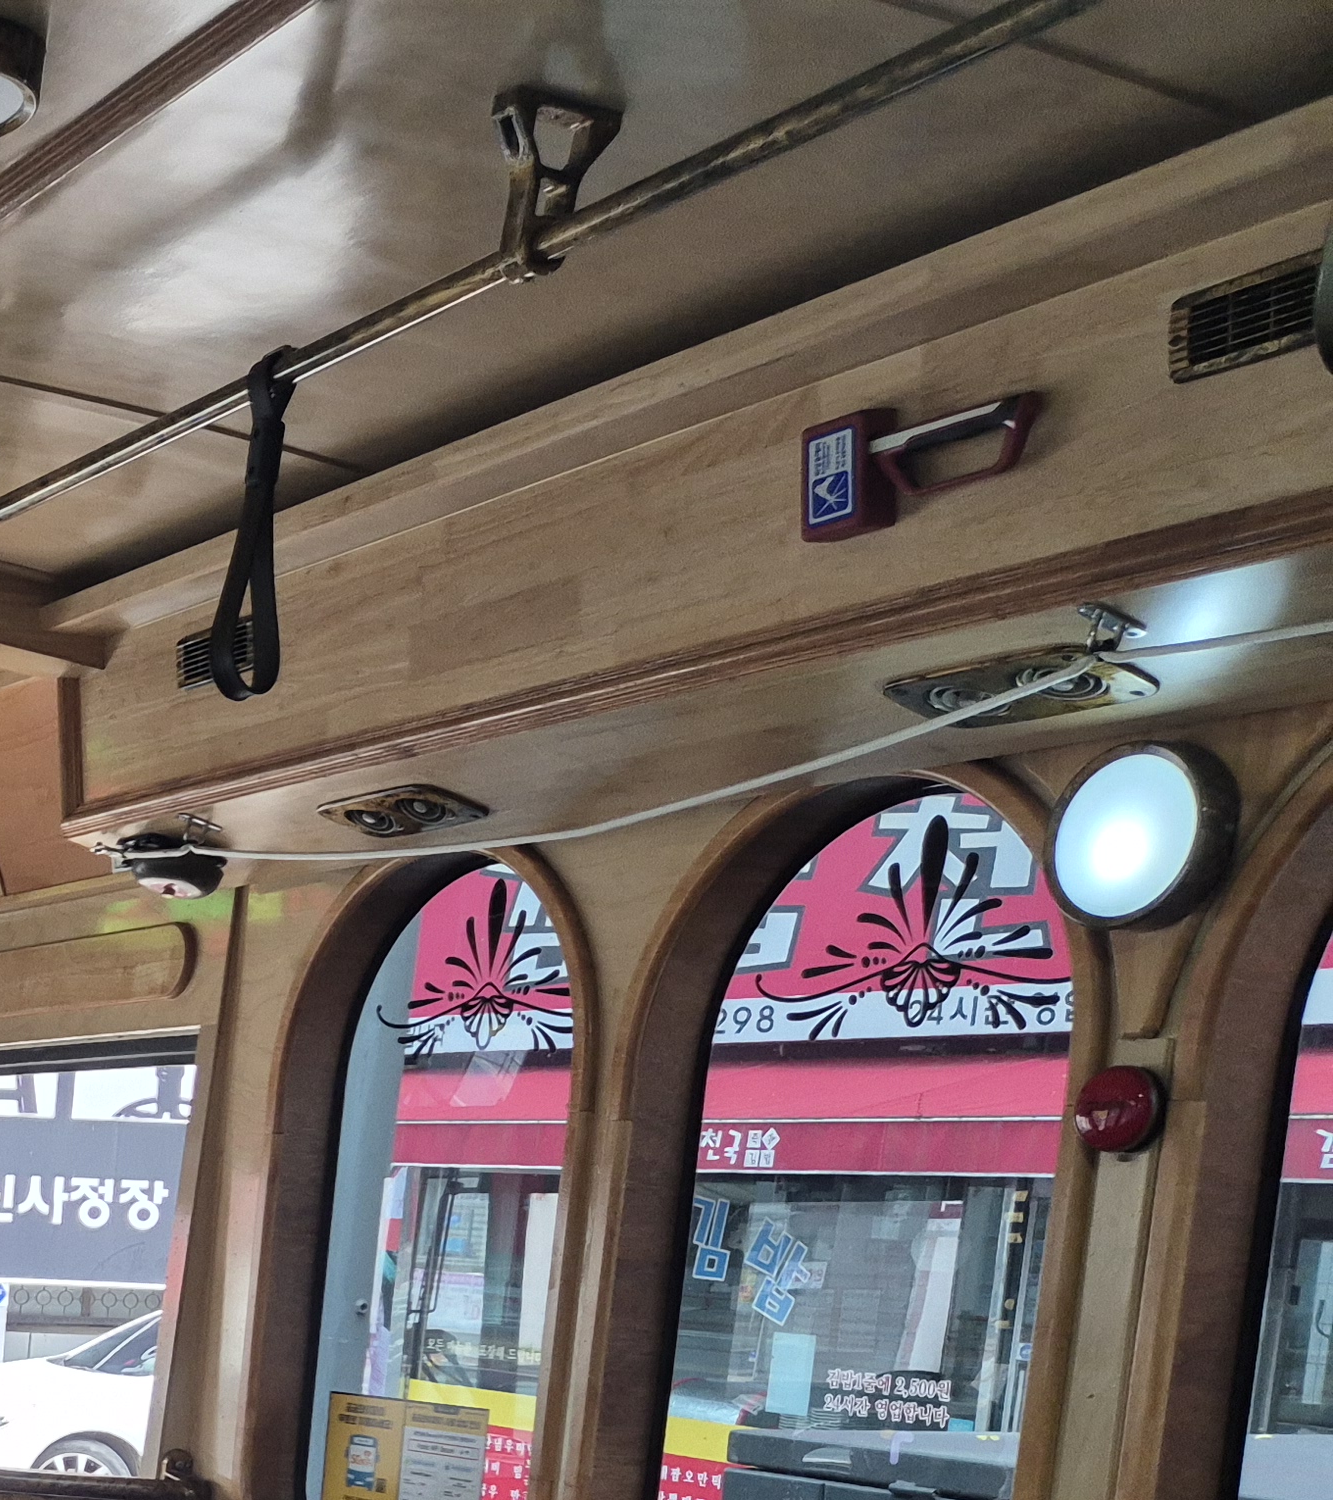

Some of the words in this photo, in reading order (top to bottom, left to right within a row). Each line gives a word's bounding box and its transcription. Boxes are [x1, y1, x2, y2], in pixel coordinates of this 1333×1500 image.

[700, 1128, 742, 1165] 천국
[826, 1368, 892, 1394] 김밥1줄에
[893, 1376, 952, 1402] 2,500원
[823, 1394, 872, 1418] 24시간
[874, 1399, 951, 1429] 영업합니다
